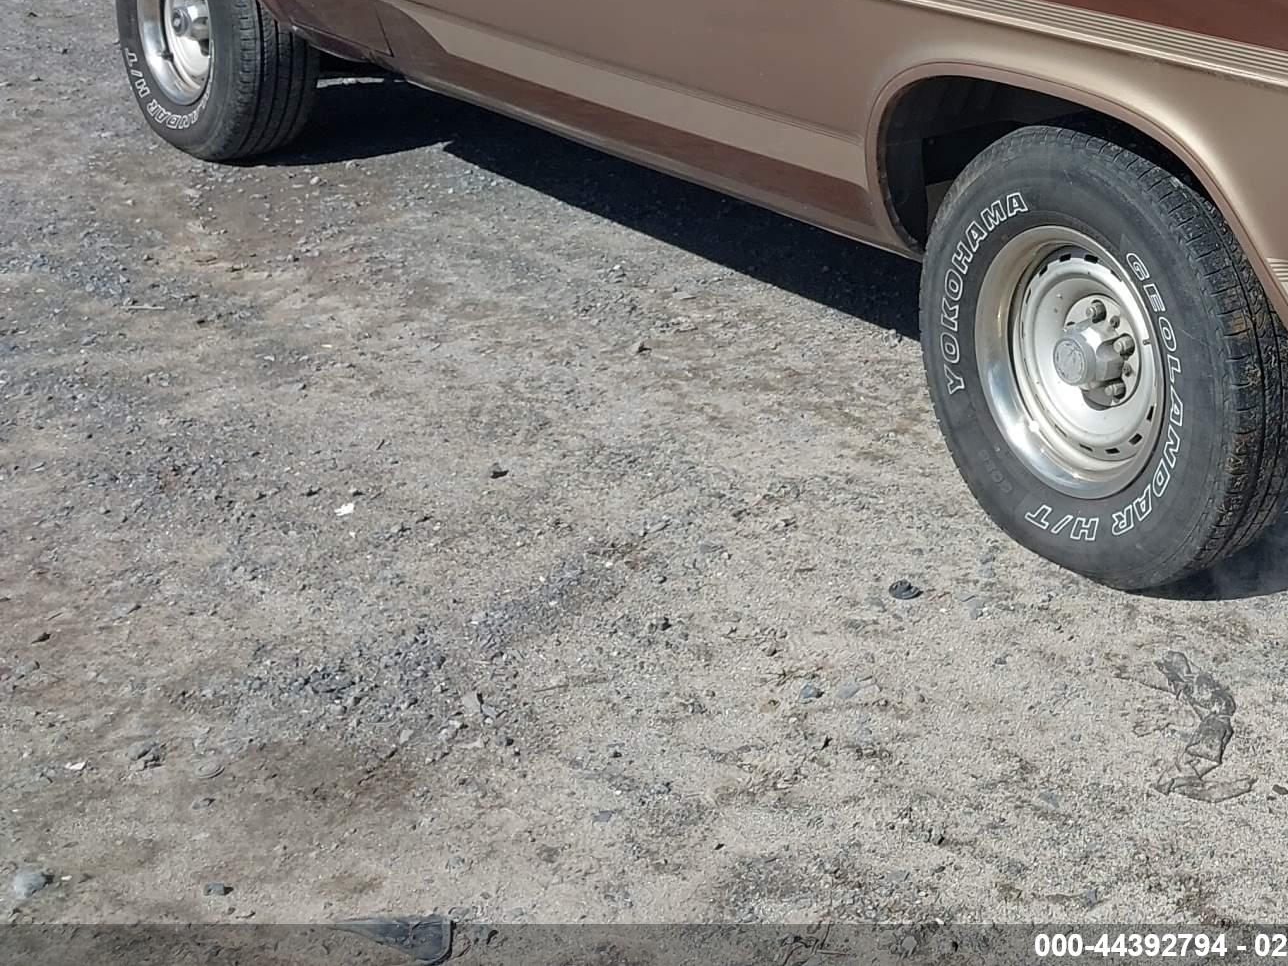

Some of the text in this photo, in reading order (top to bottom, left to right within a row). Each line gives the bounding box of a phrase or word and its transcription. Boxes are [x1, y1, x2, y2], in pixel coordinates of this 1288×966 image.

[937, 191, 1029, 396] YOKOHAMA
[1025, 252, 1186, 541] GEOLANDAR H/T
